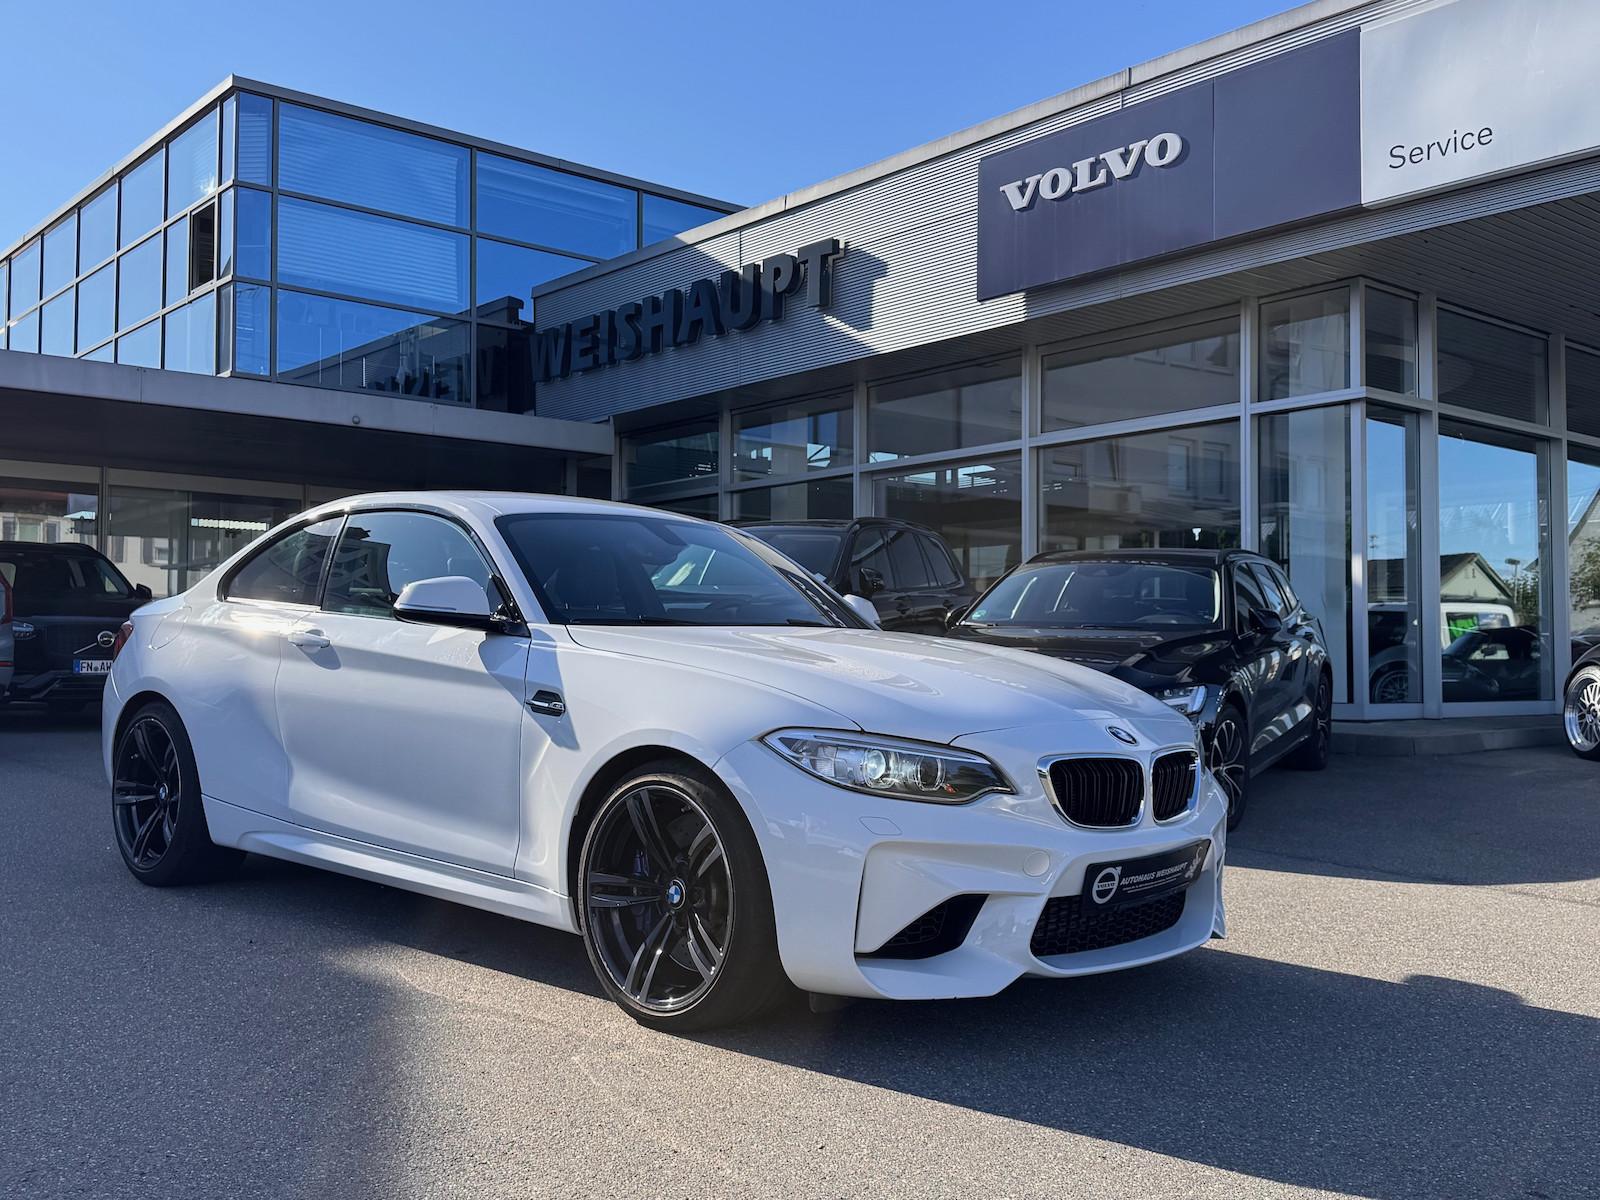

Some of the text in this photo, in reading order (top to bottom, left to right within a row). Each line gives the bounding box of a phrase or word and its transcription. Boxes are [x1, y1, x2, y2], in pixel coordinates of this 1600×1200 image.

[1388, 126, 1494, 170] Service
[999, 132, 1183, 211] VOLVO
[529, 237, 845, 383] WEISHAUPT
[80, 661, 93, 672] FN
[1120, 871, 1156, 886] AUTOHAUS
